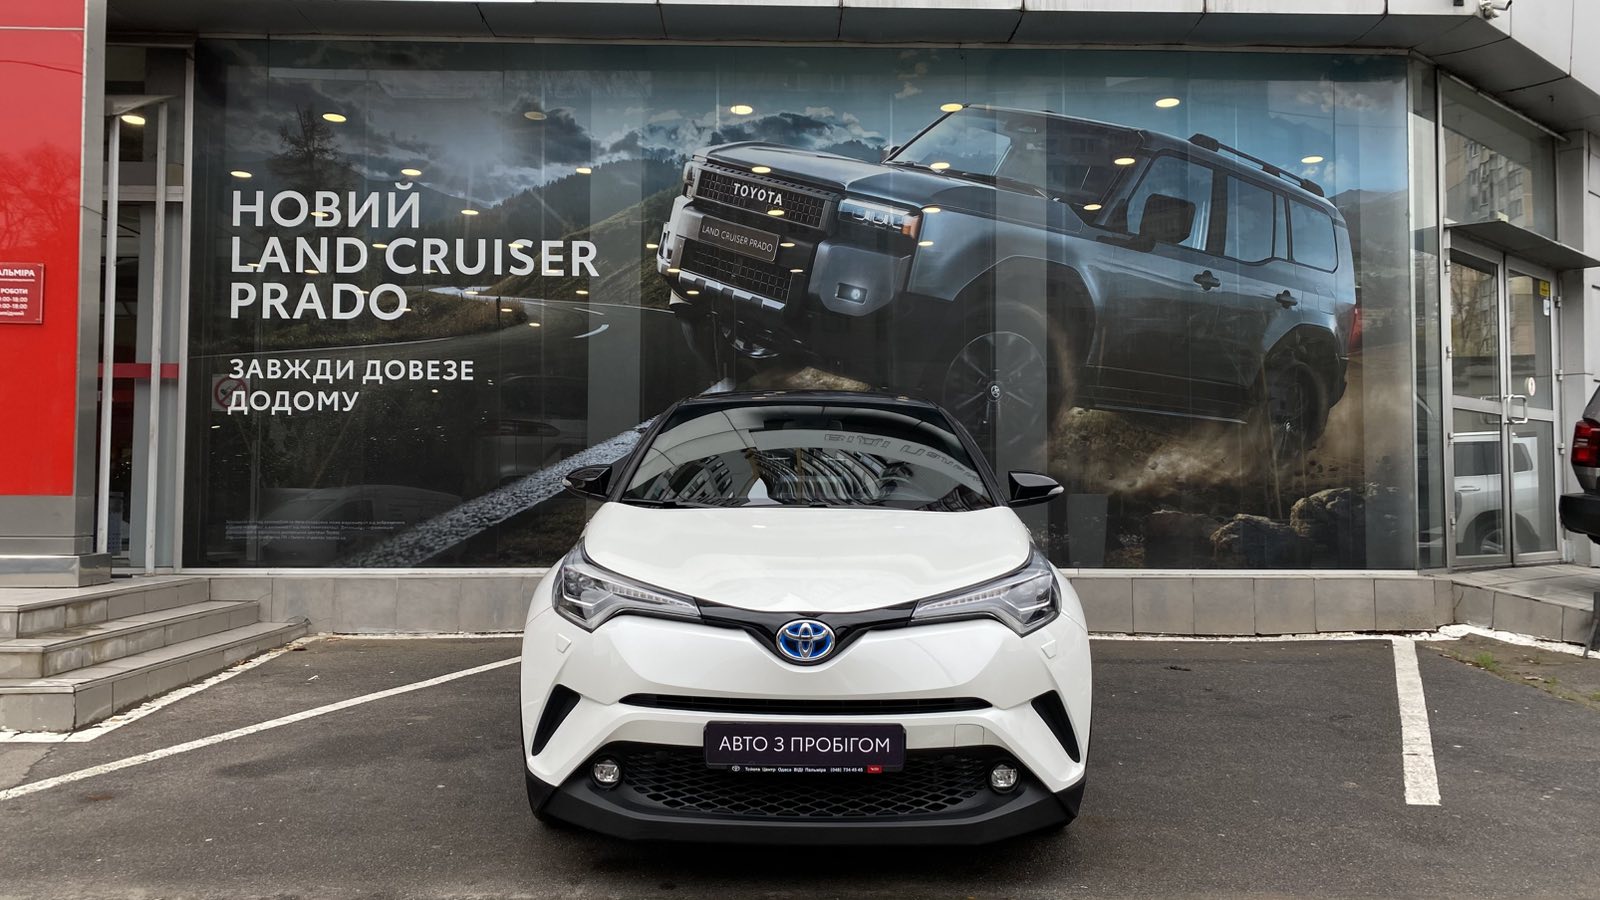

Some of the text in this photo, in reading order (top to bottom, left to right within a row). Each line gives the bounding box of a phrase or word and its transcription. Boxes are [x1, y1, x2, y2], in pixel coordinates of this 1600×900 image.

[232, 182, 420, 228] НОВИЙ
[733, 183, 783, 206] TOYOTA
[702, 225, 773, 253] LAND CRUISER PRADO
[231, 237, 600, 277] LAND CRUISER
[230, 283, 409, 321] PRADO
[228, 358, 474, 385] ЗАВЖДИ ДОВЕЗЕ
[227, 390, 359, 416] ДОДОМУ
[718, 736, 890, 753] АВТО З ПРОБІГОМ
